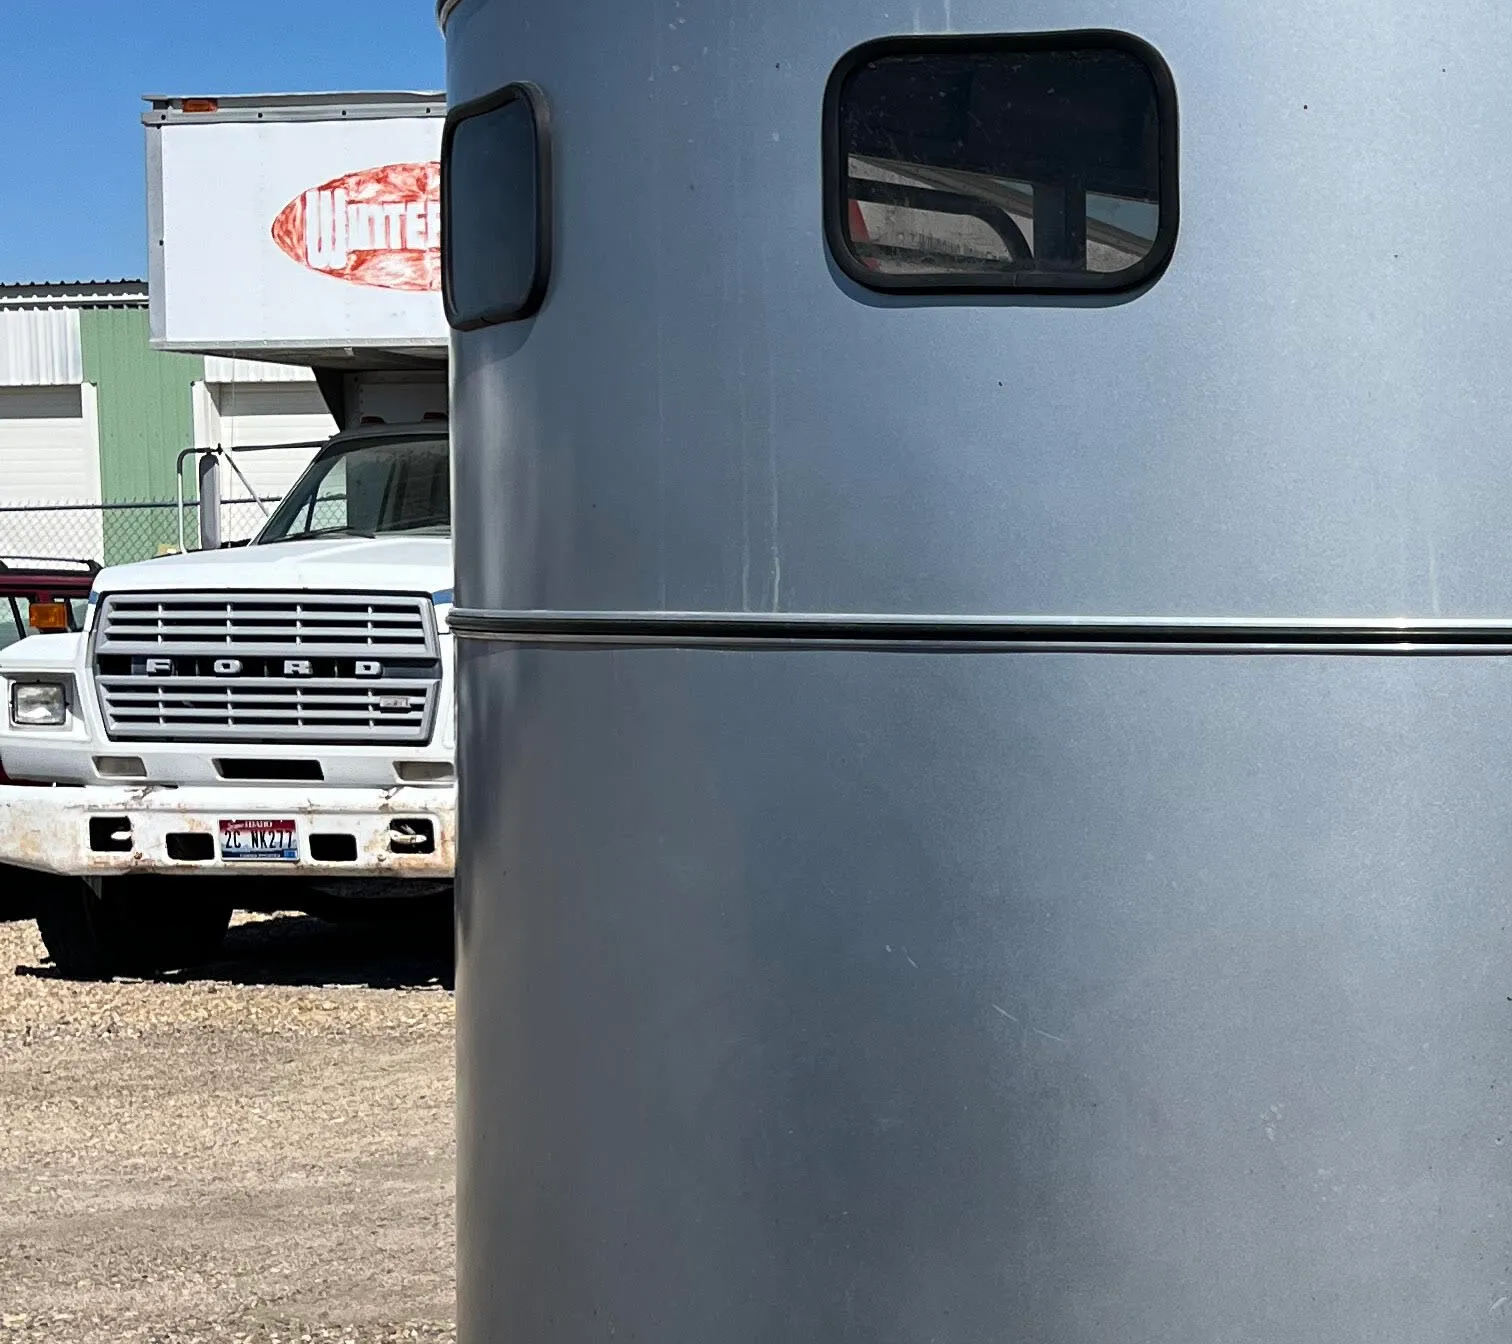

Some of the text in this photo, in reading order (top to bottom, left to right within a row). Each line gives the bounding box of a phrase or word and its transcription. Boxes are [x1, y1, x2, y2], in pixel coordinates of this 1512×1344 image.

[146, 658, 384, 676] FORD
[225, 830, 292, 848] 2C NK277
